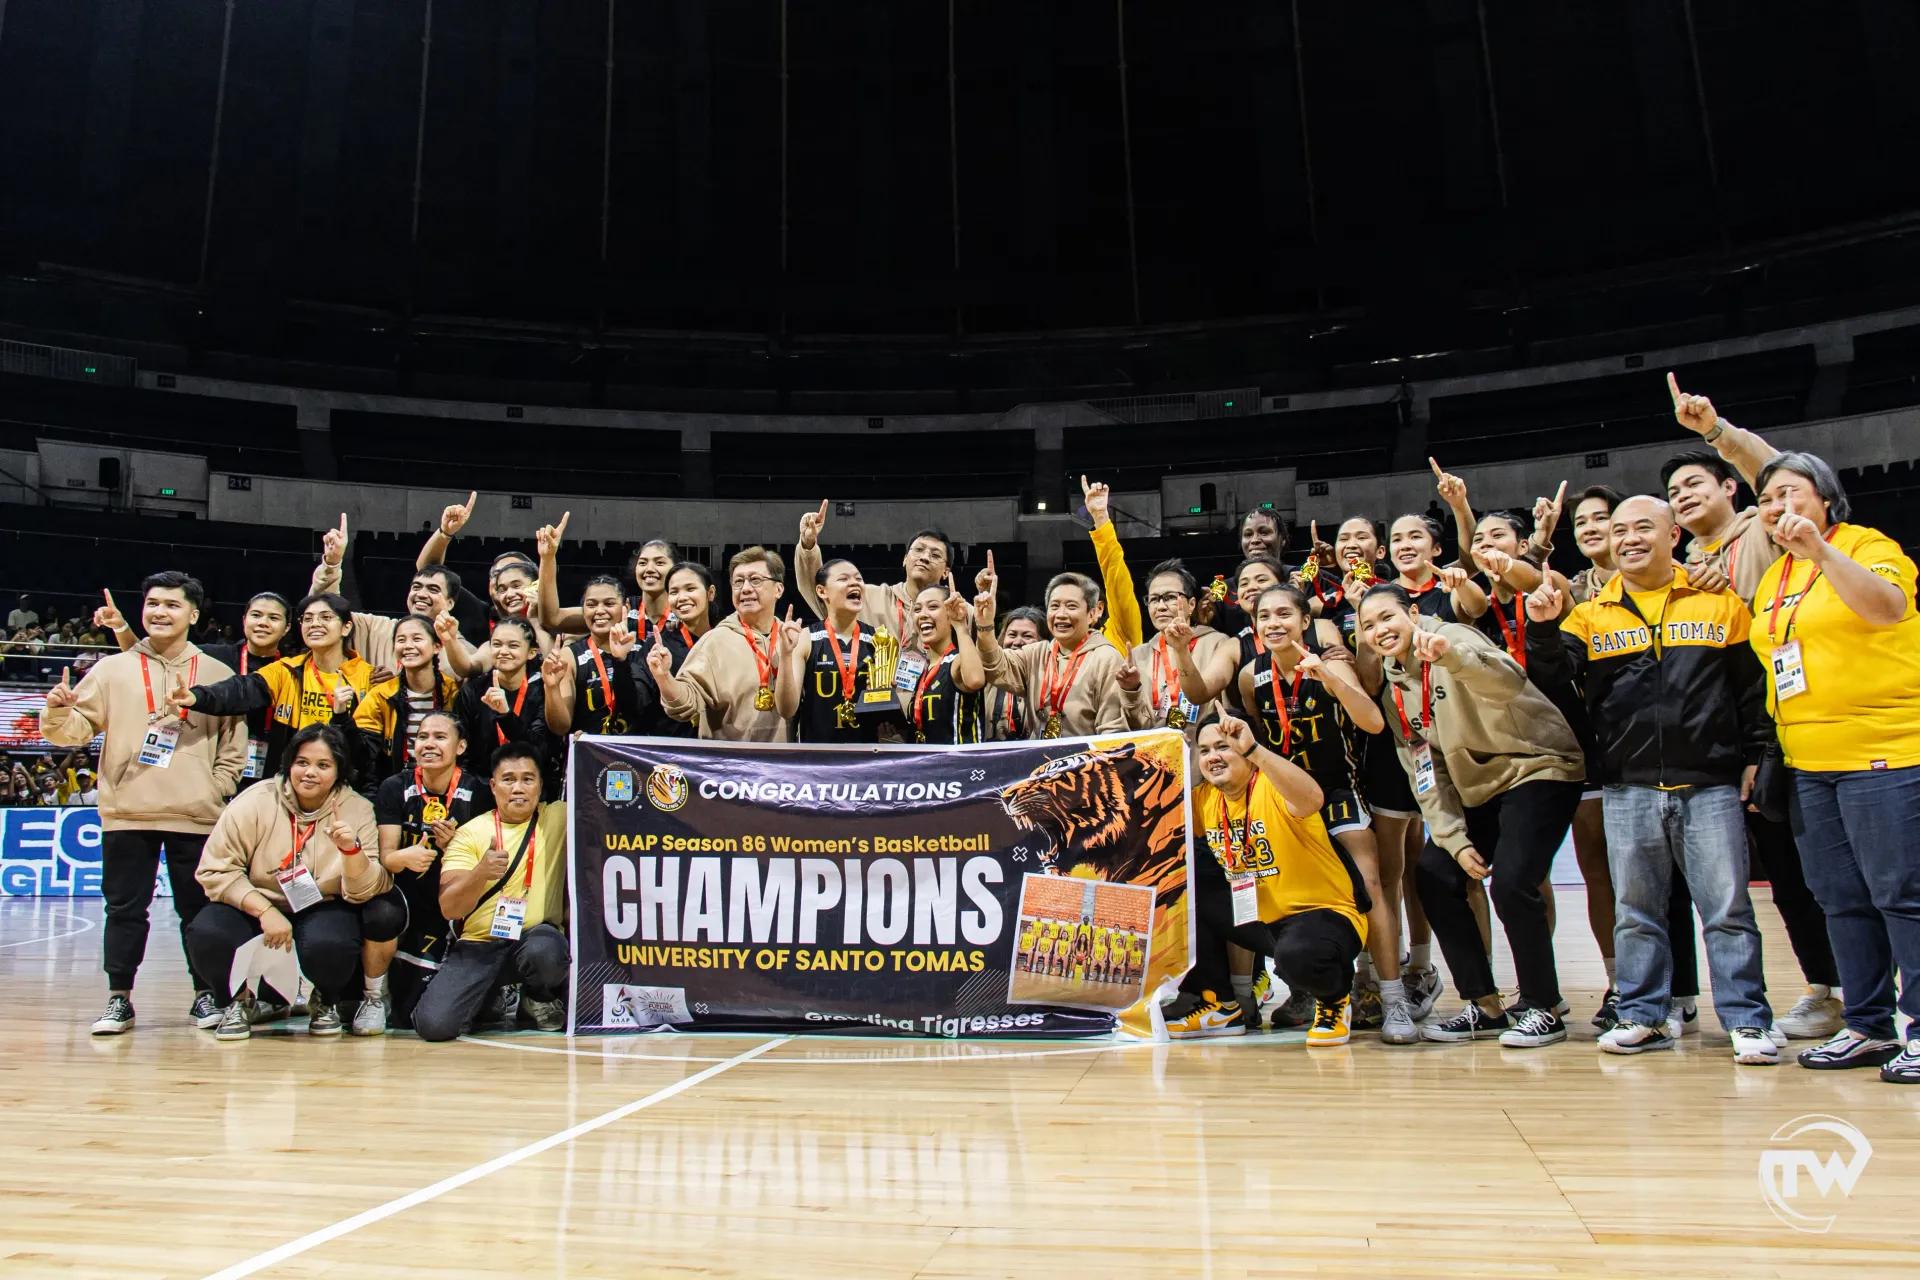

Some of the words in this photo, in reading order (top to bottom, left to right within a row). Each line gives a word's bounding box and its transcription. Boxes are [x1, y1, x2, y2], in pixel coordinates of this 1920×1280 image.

[229, 478, 250, 489] 214
[1592, 627, 1648, 653] SANTO
[1667, 622, 1725, 643] TOMAS
[1262, 713, 1324, 745] UST
[699, 781, 963, 801] CONGRATULATIONS
[1327, 800, 1352, 822] 11
[605, 834, 658, 850] UAAP
[662, 834, 738, 852] Season
[741, 835, 767, 852] 86
[770, 836, 869, 853] Women’s
[873, 834, 990, 853] Basketball
[602, 854, 1004, 945] CHAMPIONS
[421, 935, 438, 953] 7
[617, 943, 750, 969] UNIVERSITY
[755, 948, 788, 970] OF
[795, 948, 884, 971] SANTO
[890, 950, 985, 972] TOMAS
[921, 1013, 1045, 1038] Tigresses
